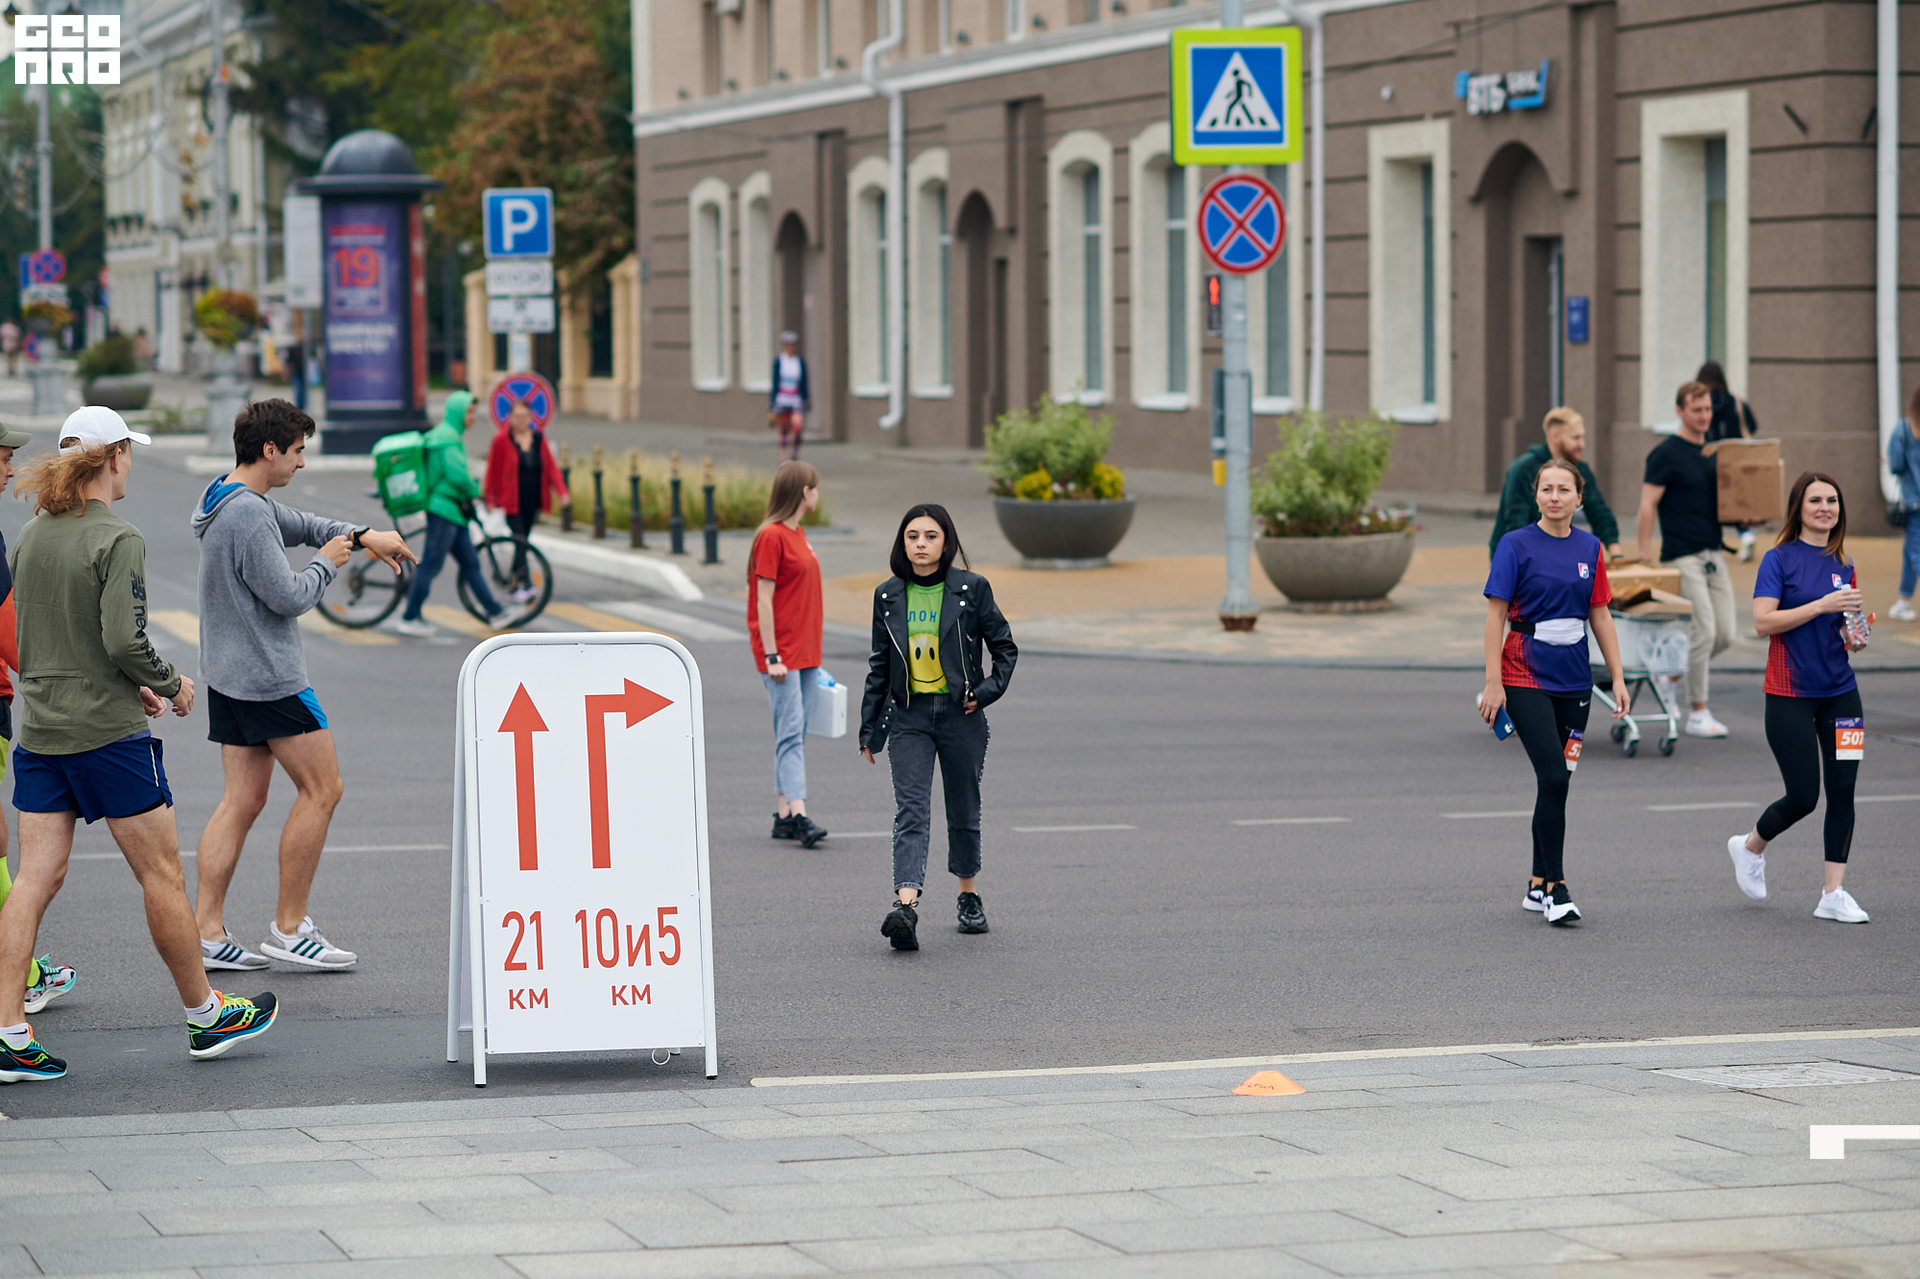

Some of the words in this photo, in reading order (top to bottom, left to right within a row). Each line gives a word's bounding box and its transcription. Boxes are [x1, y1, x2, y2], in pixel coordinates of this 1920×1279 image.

[501, 198, 538, 252] P
[333, 245, 380, 288] 19
[501, 910, 544, 972] 21
